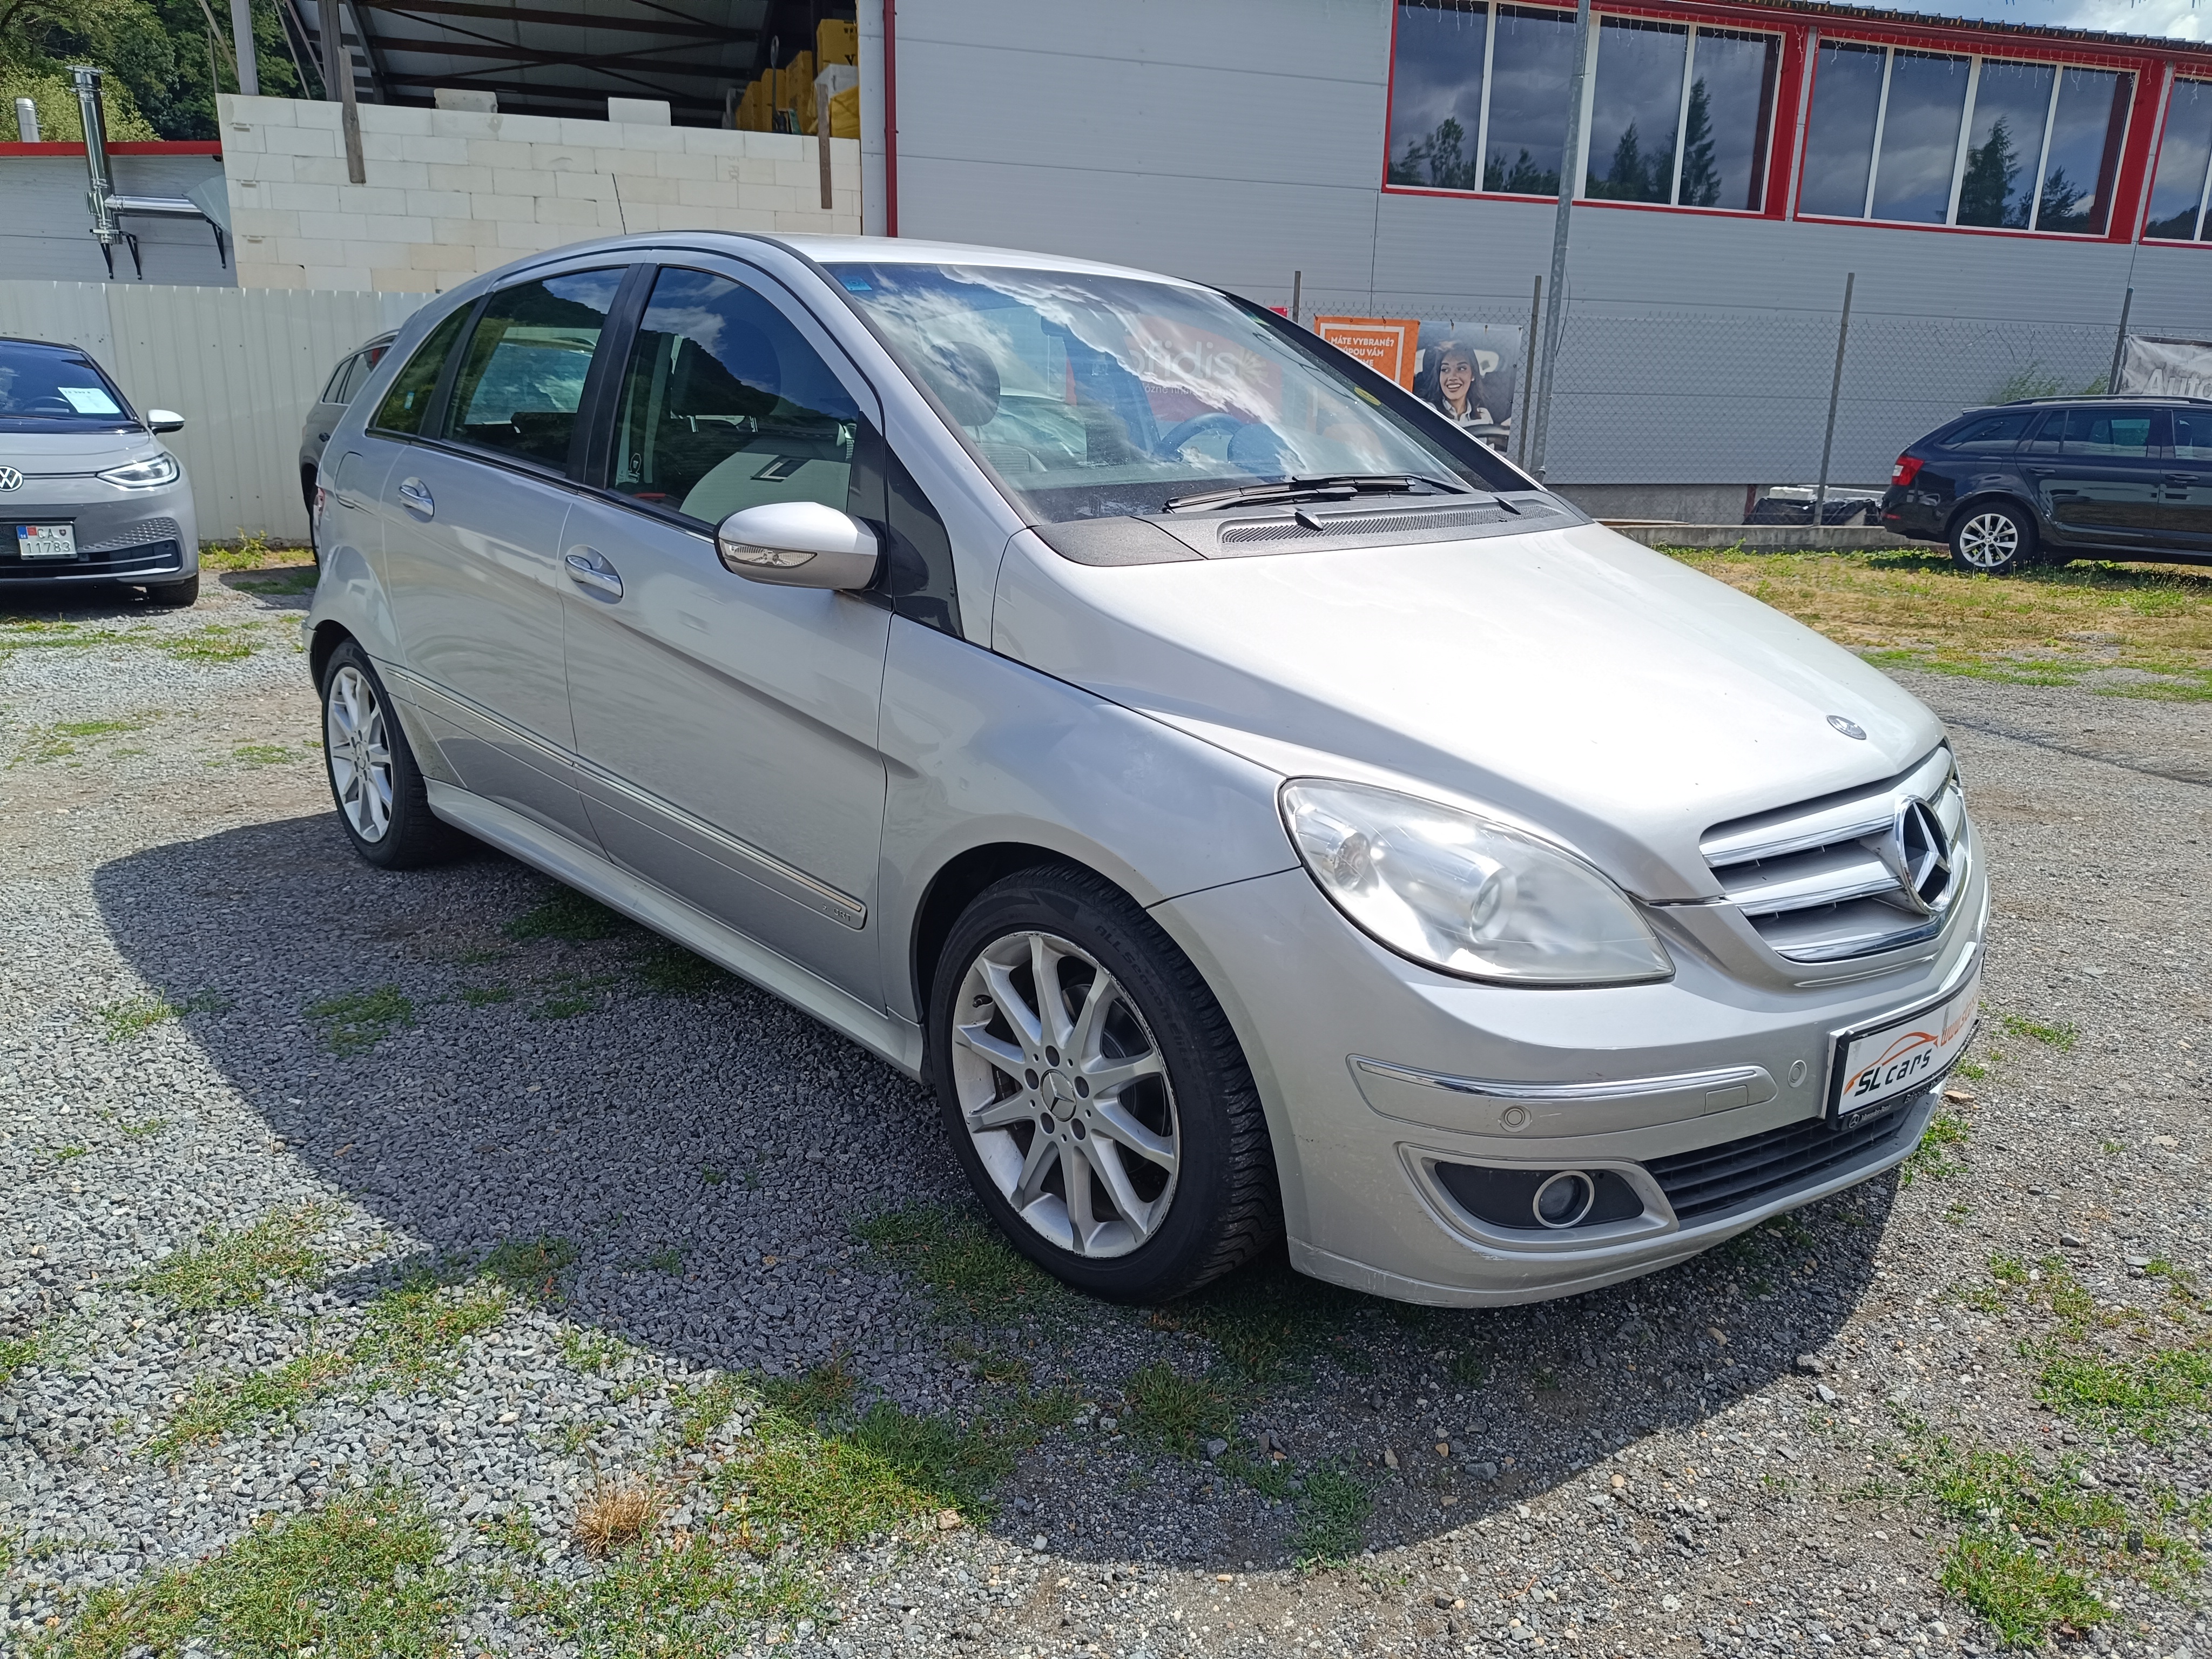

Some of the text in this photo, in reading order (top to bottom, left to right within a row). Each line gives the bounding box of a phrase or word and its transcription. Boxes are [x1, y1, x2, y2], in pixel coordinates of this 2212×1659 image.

[1331, 335, 1394, 347] MÁTE VYBRANÉ?
[1341, 346, 1384, 356] ÚPOU VÁM
[1130, 340, 1236, 379] ofidis
[26, 541, 71, 554] 11783
[821, 902, 852, 921] SORT
[1854, 1065, 1884, 1097] SL
[1885, 1049, 1932, 1084] cars
